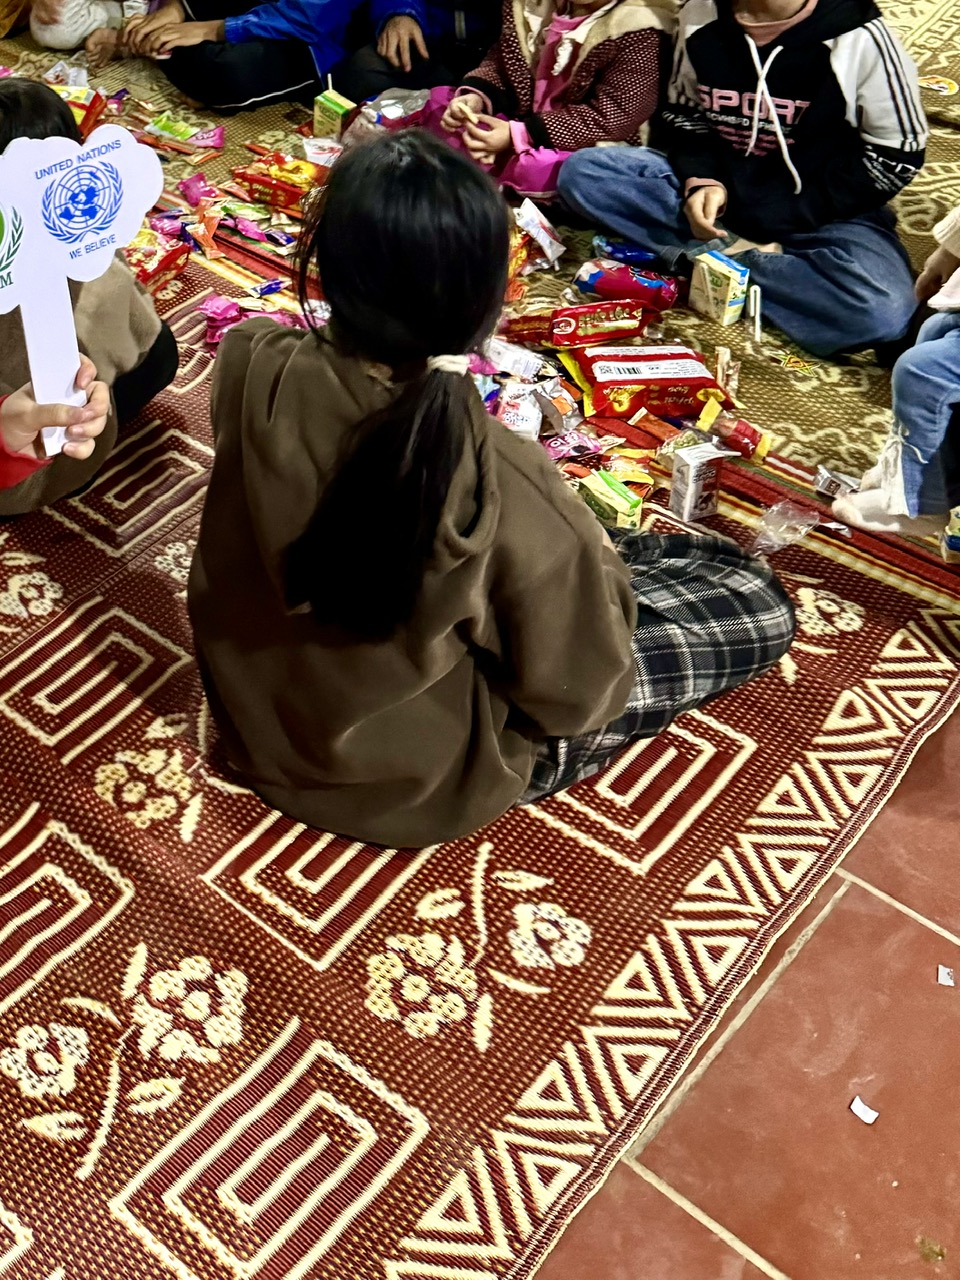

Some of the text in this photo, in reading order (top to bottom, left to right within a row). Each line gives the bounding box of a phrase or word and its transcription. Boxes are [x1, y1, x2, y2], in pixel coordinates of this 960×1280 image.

[34, 139, 122, 180] UNITED NATIONS
[69, 233, 117, 260] WE BELIEVE
